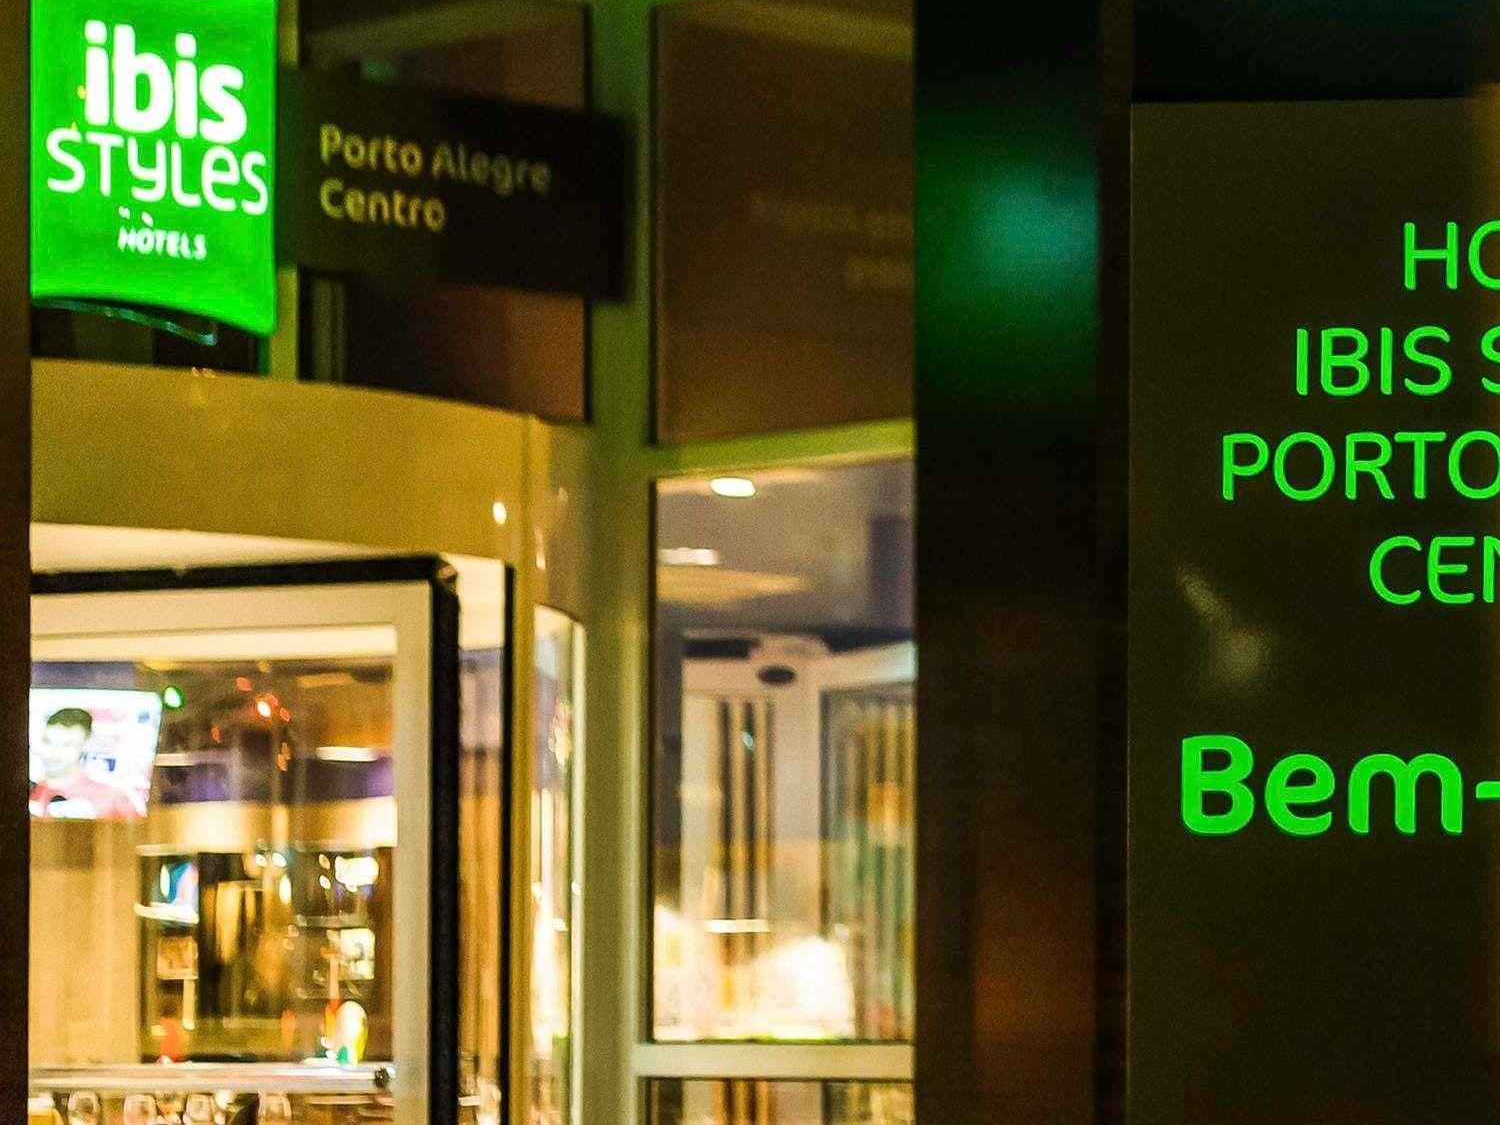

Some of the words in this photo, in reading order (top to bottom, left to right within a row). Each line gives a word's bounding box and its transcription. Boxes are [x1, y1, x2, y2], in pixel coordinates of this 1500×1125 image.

[83, 19, 249, 145] ibis
[319, 123, 424, 177] Porto
[431, 141, 552, 198] Alegre
[319, 177, 447, 233] Centro
[1295, 324, 1453, 397] IBIS
